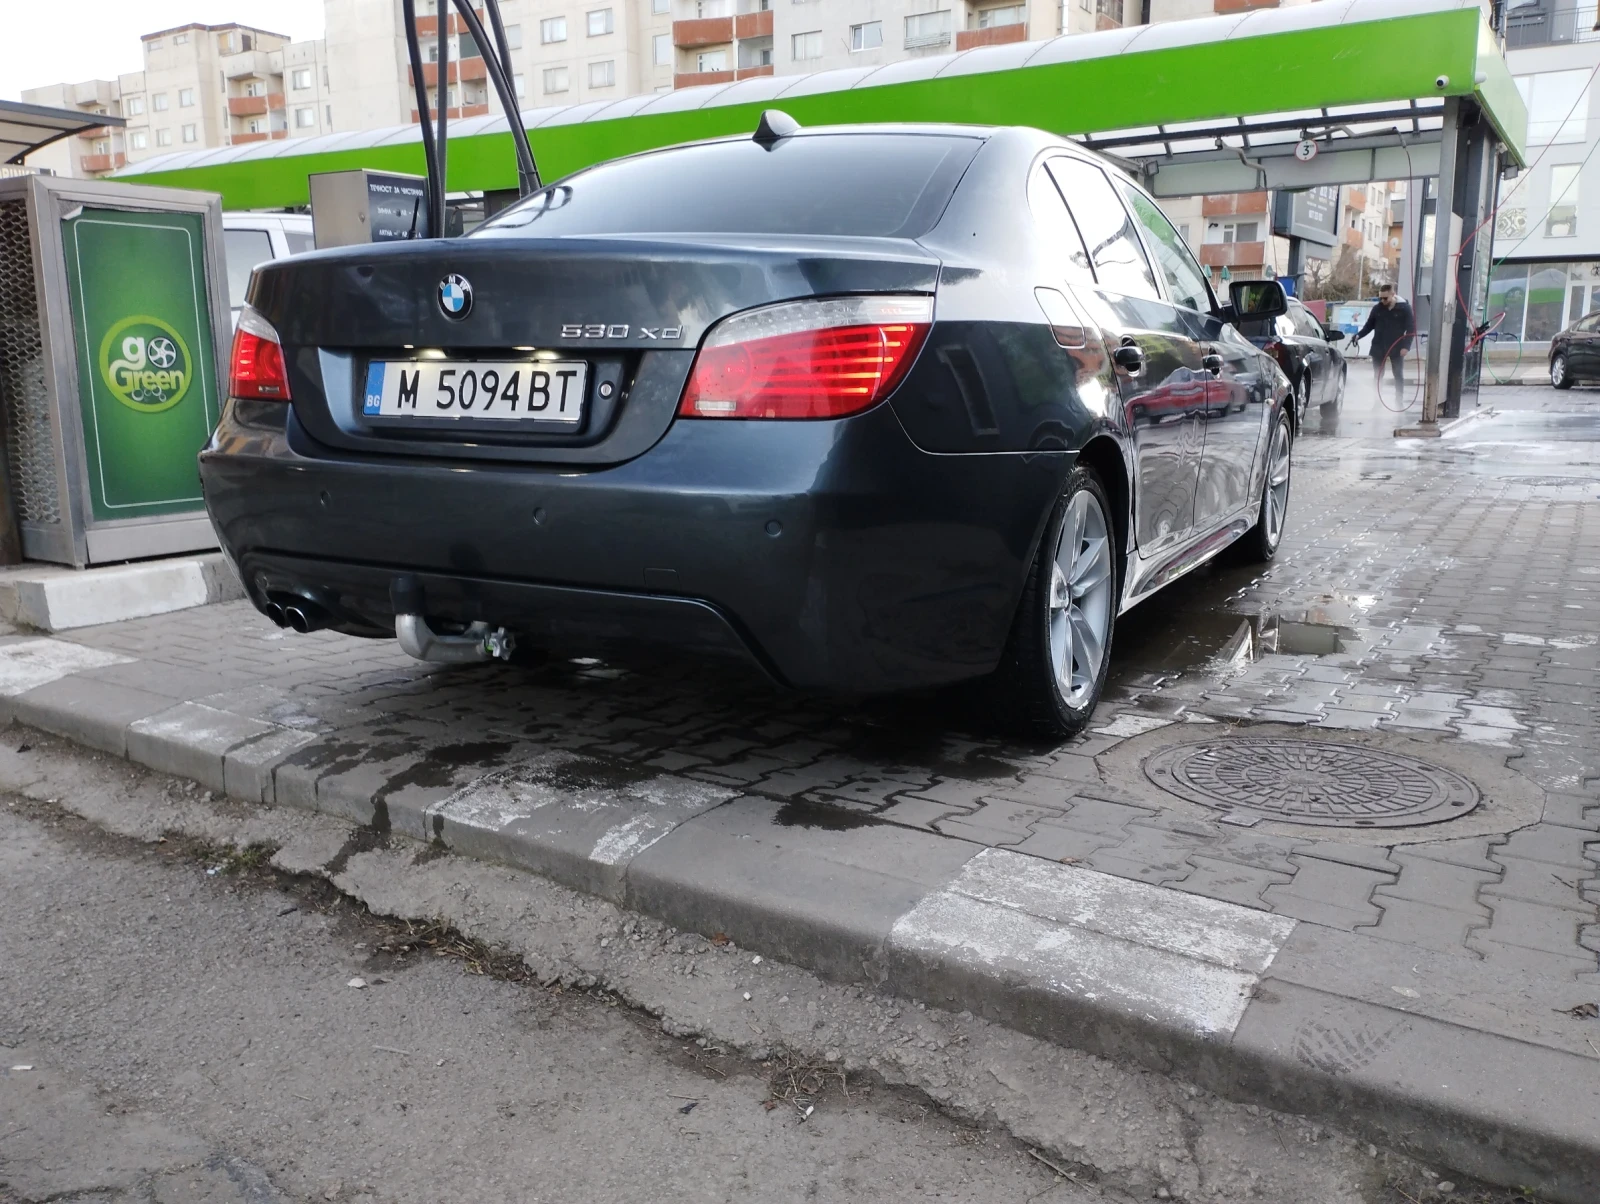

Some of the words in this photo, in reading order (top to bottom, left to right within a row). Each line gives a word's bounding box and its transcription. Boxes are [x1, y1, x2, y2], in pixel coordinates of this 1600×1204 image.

[561, 324, 630, 339] 530
[638, 324, 684, 340] xd
[108, 360, 185, 394] Green
[366, 394, 381, 408] BG
